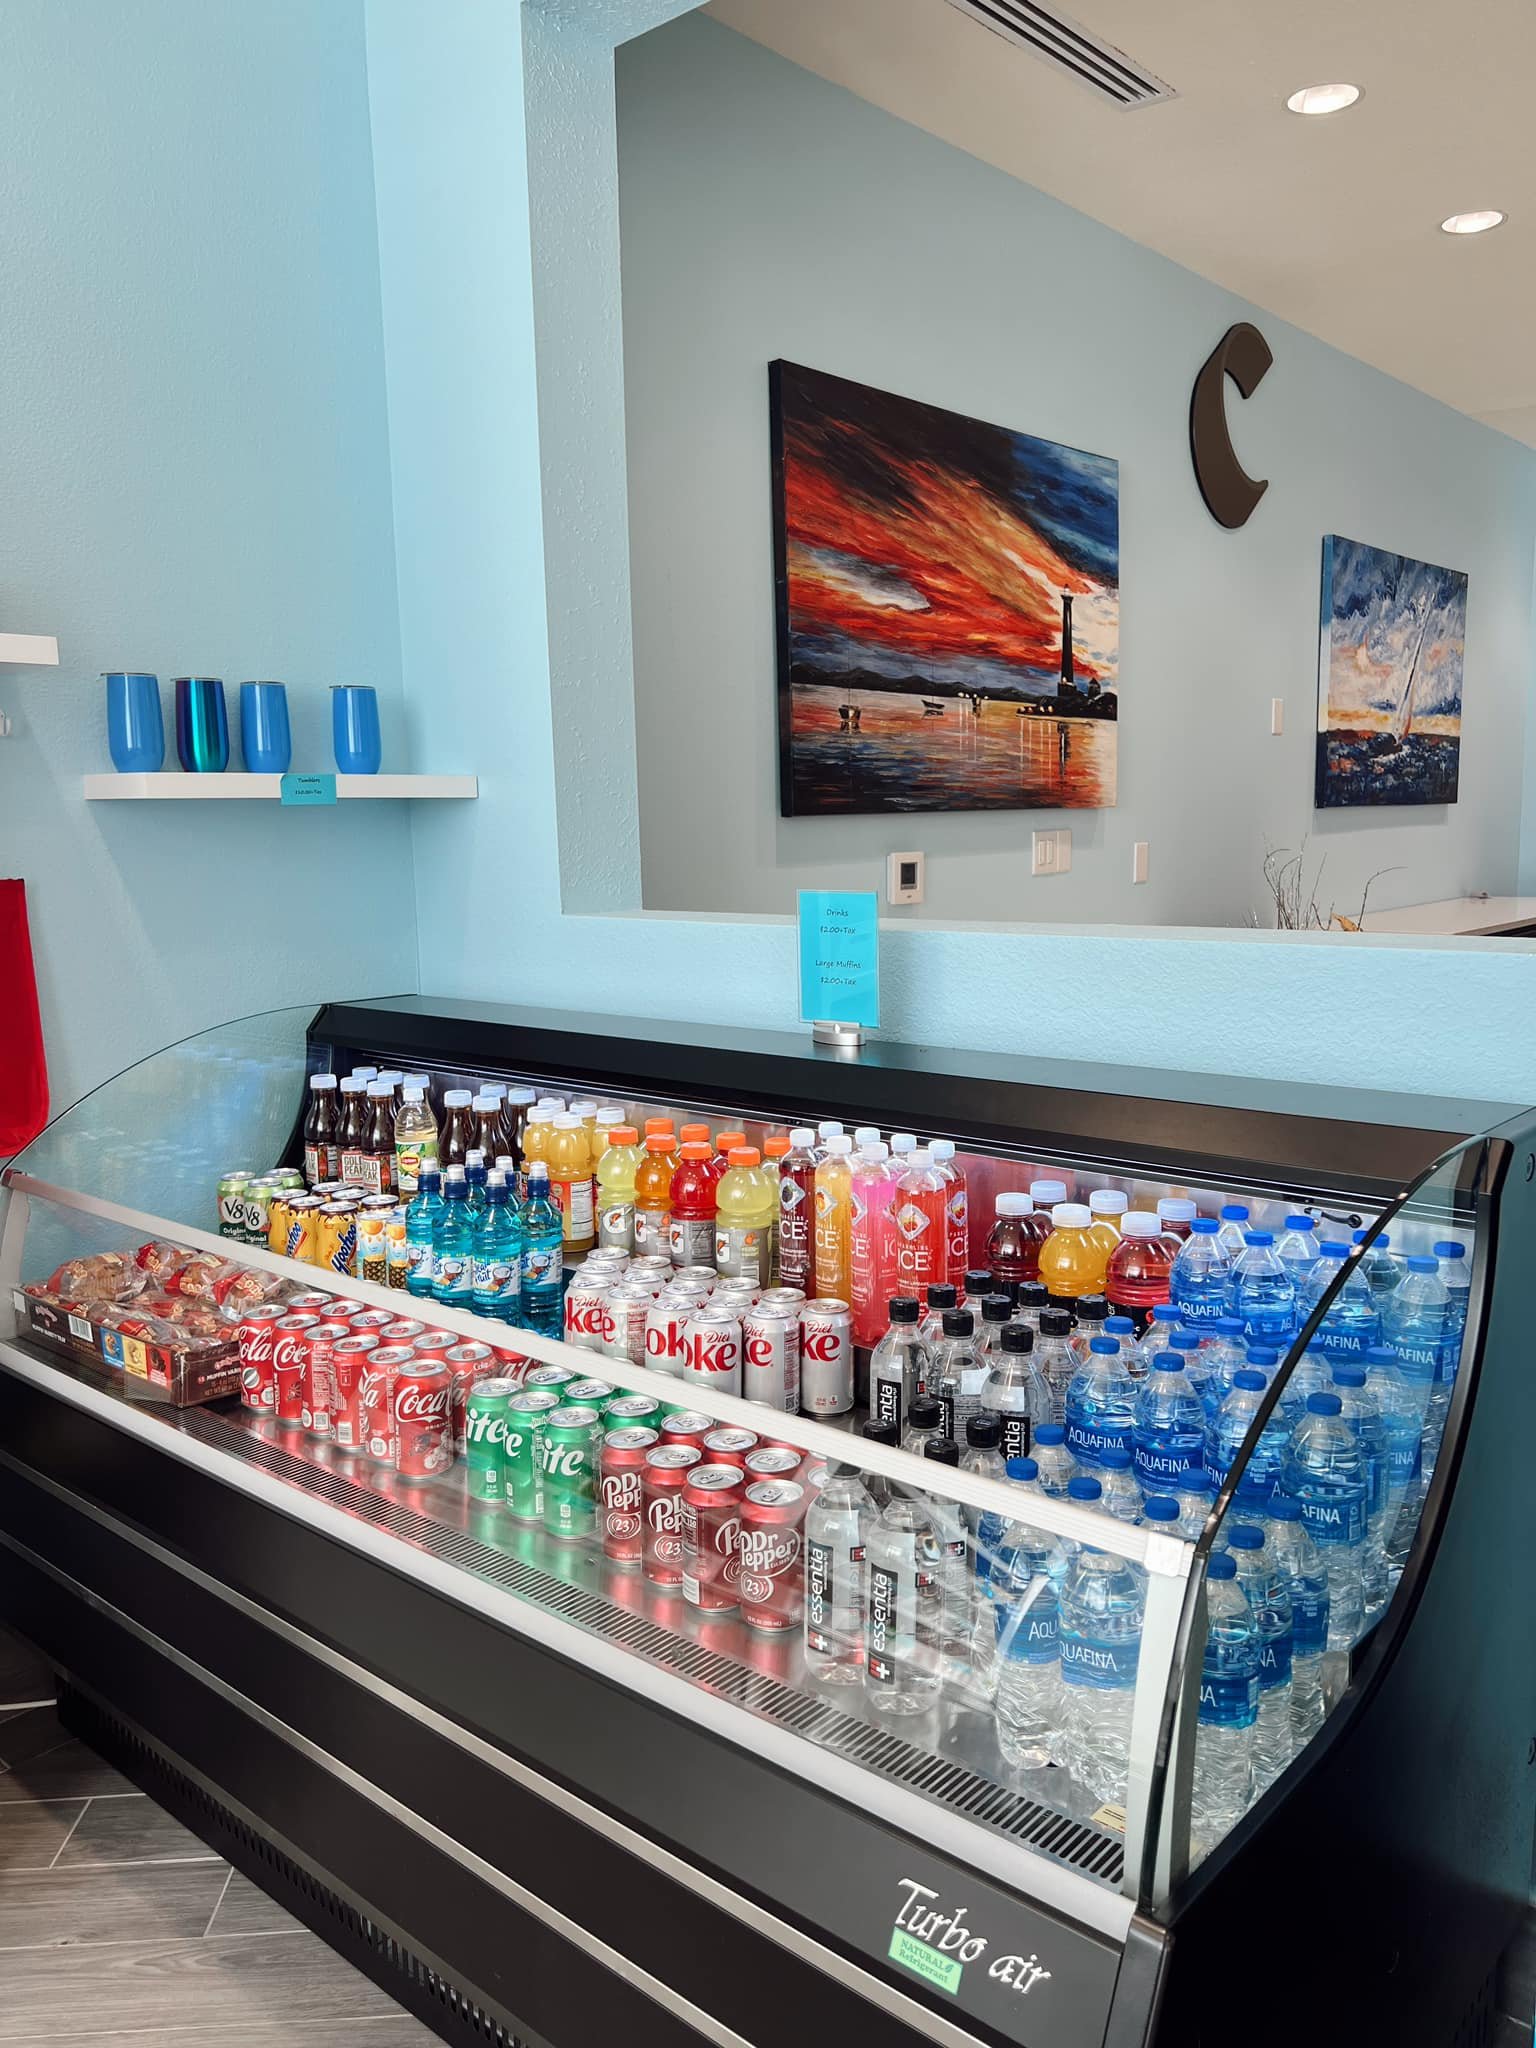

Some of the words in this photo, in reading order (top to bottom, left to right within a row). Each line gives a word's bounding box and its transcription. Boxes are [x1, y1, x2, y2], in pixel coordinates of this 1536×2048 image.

[826, 909, 849, 917] Drinks
[815, 959, 834, 968] Large
[836, 960, 861, 969] Muffins
[344, 1156, 362, 1166] GOL
[344, 1165, 363, 1175] PEA
[224, 1199, 244, 1219] V8
[245, 1206, 260, 1226] V8
[816, 1228, 838, 1249] CE
[897, 1247, 929, 1271] ICE
[574, 1295, 600, 1307] Diet
[565, 1297, 603, 1334] ke
[806, 1319, 834, 1333] Diet
[704, 1330, 731, 1344] Diet
[800, 1320, 842, 1362] ke
[466, 1408, 505, 1443] ite
[1068, 1426, 1124, 1449] AQUAFINA
[543, 1438, 585, 1476] ite
[1135, 1448, 1190, 1473] AQUAFINA
[1302, 1504, 1342, 1525] AFINA
[615, 1519, 630, 1533] 23
[665, 1541, 681, 1555] 23
[740, 1530, 797, 1572] Pepper
[751, 1531, 778, 1550] Dr
[746, 1579, 760, 1595] 23
[811, 1548, 824, 1624] essentia
[873, 1572, 887, 1652] essentia
[895, 1877, 988, 1962] Turbo
[988, 1954, 1052, 1994] air
[901, 1938, 944, 1971] NATURAL
[899, 1949, 948, 1983] Refrigerant
